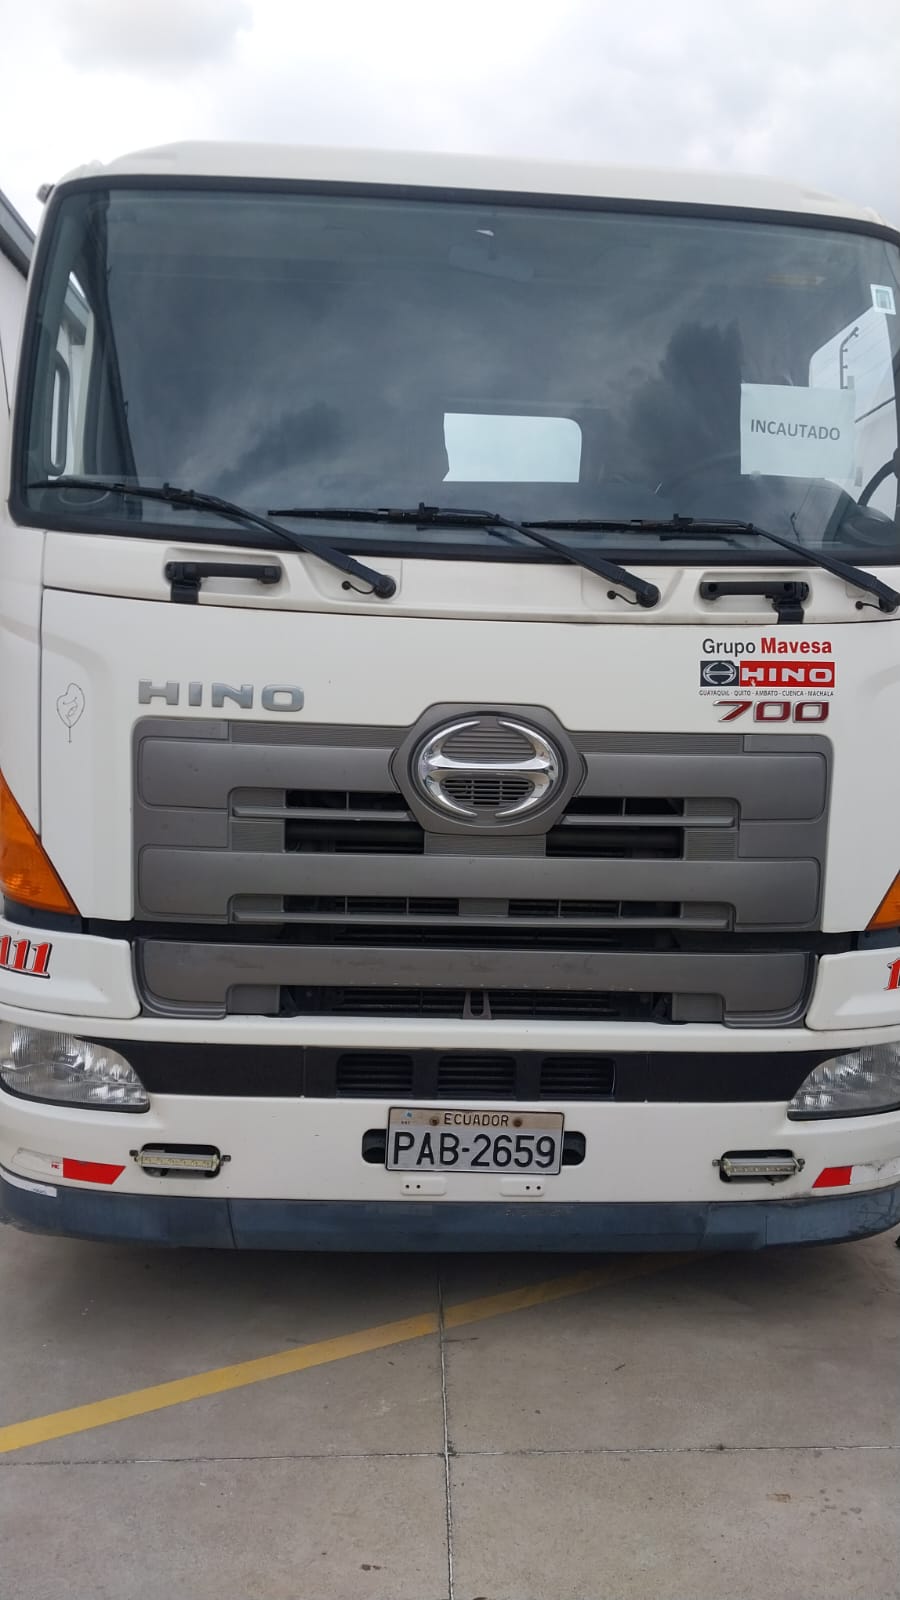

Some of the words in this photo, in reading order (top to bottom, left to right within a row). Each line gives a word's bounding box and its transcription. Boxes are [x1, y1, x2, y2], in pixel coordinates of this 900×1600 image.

[750, 419, 841, 441] INCAUTADO
[702, 638, 756, 657] Grupo
[761, 637, 832, 654] Mavesa
[741, 667, 833, 683] HINO
[138, 678, 305, 712] HINO
[713, 700, 829, 723] 700
[444, 1112, 509, 1127] ECUADOR
[393, 1131, 556, 1168] PAB-2659
